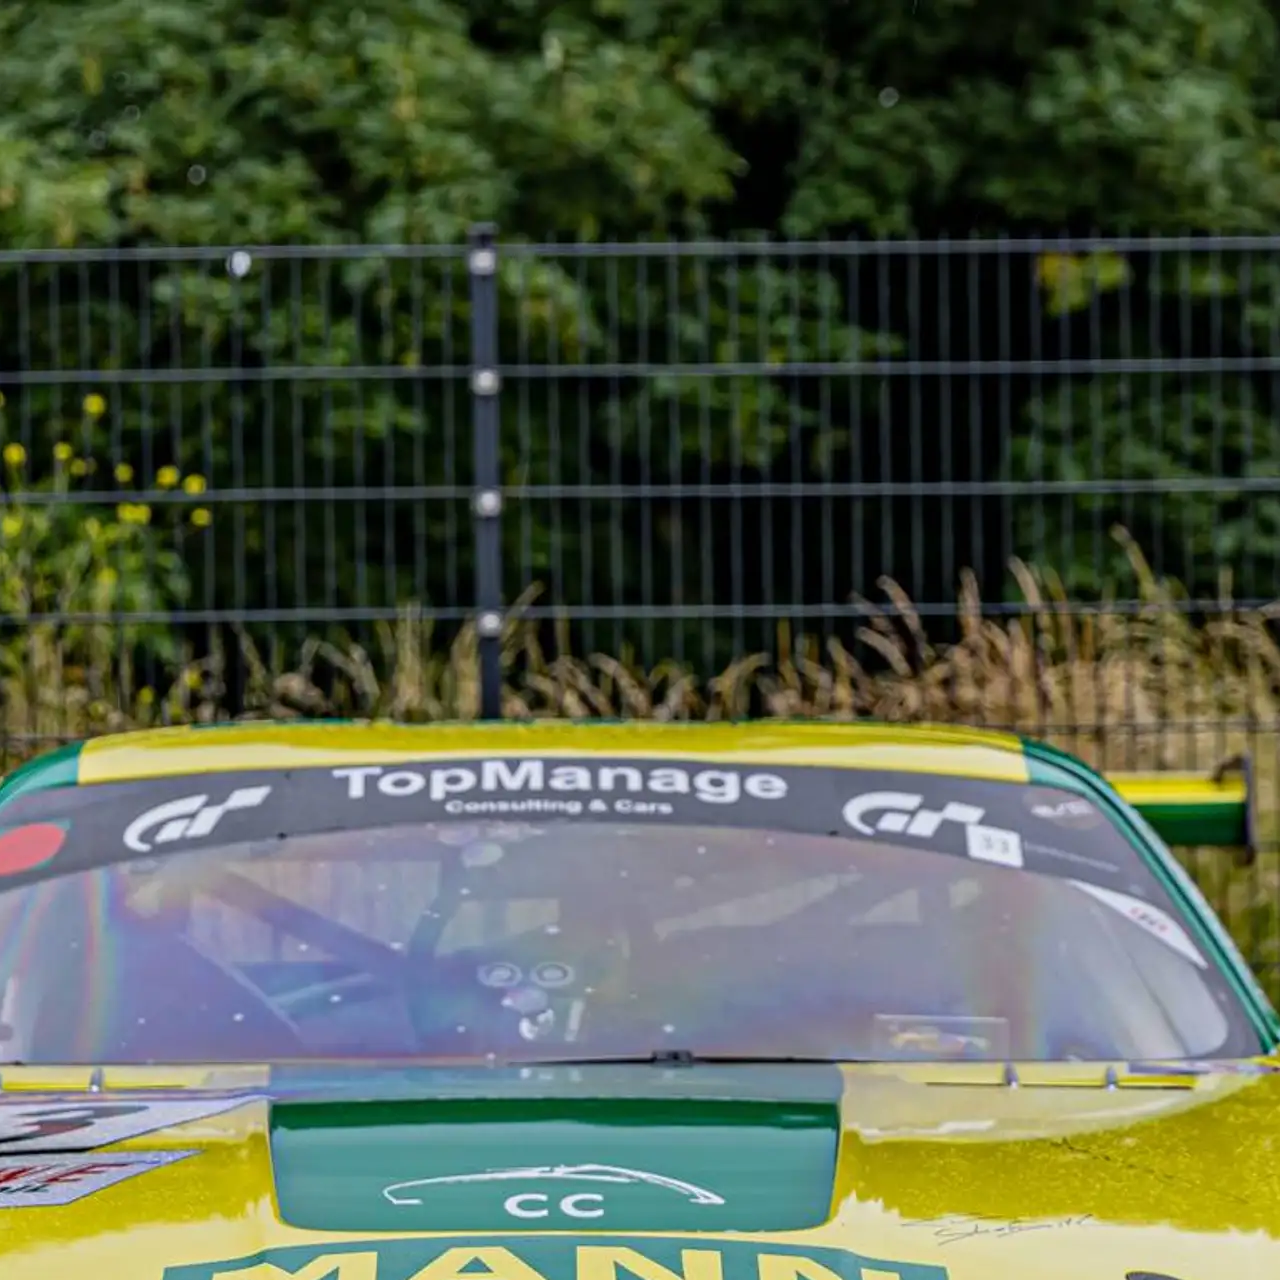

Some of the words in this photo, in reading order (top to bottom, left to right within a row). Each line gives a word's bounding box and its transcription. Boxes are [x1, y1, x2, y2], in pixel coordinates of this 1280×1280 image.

[332, 760, 788, 803] TopManage
[444, 799, 583, 815] Consulting
[589, 799, 607, 812] &
[614, 799, 673, 814] Cars
[503, 1193, 605, 1218] CC
